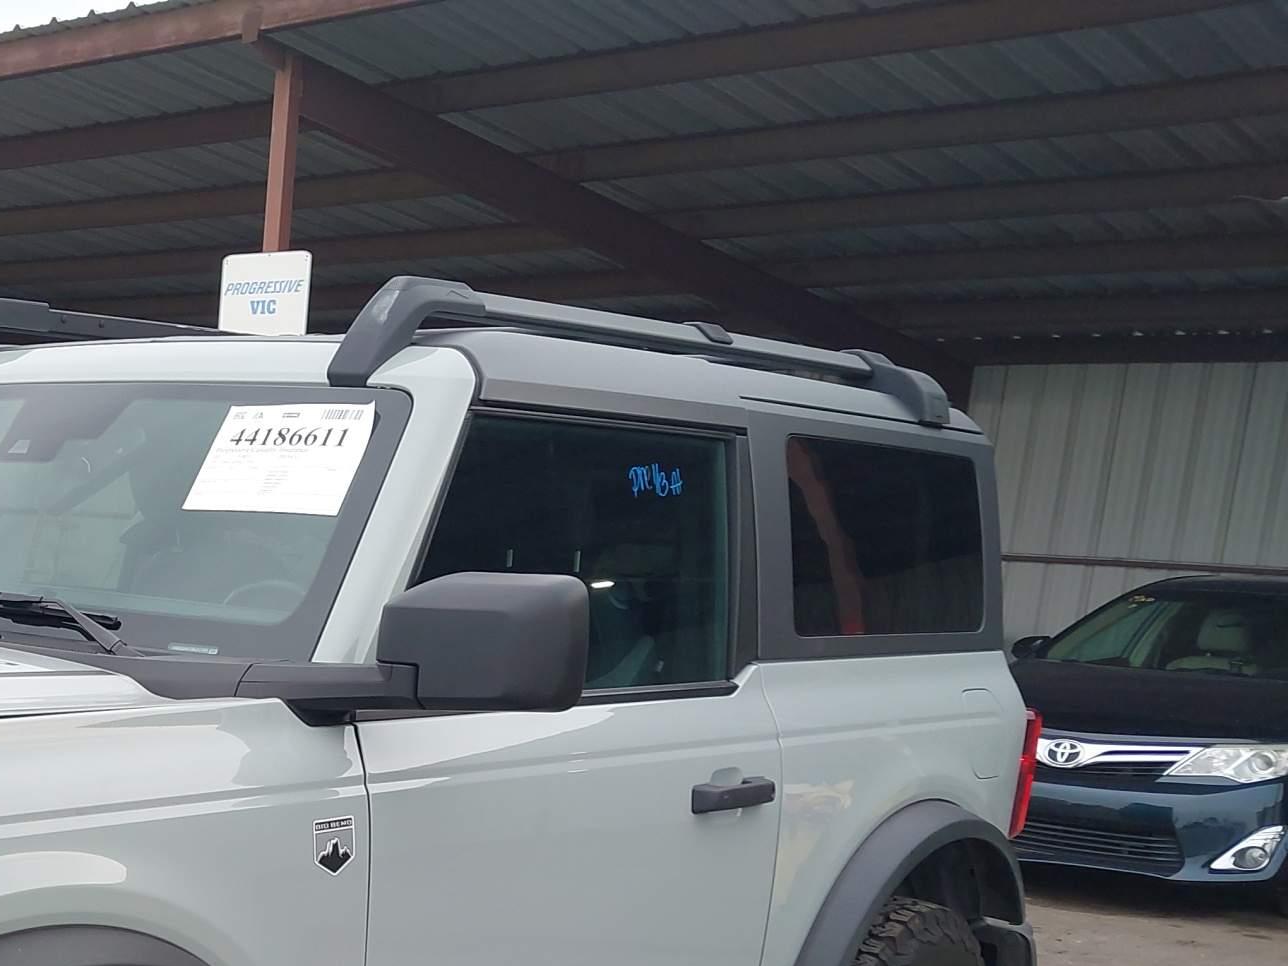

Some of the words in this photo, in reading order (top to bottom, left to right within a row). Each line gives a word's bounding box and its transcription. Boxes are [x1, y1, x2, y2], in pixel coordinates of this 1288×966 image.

[224, 280, 304, 295] PROGRESSIVE
[249, 300, 277, 315] VIC
[230, 427, 349, 447] 44186611
